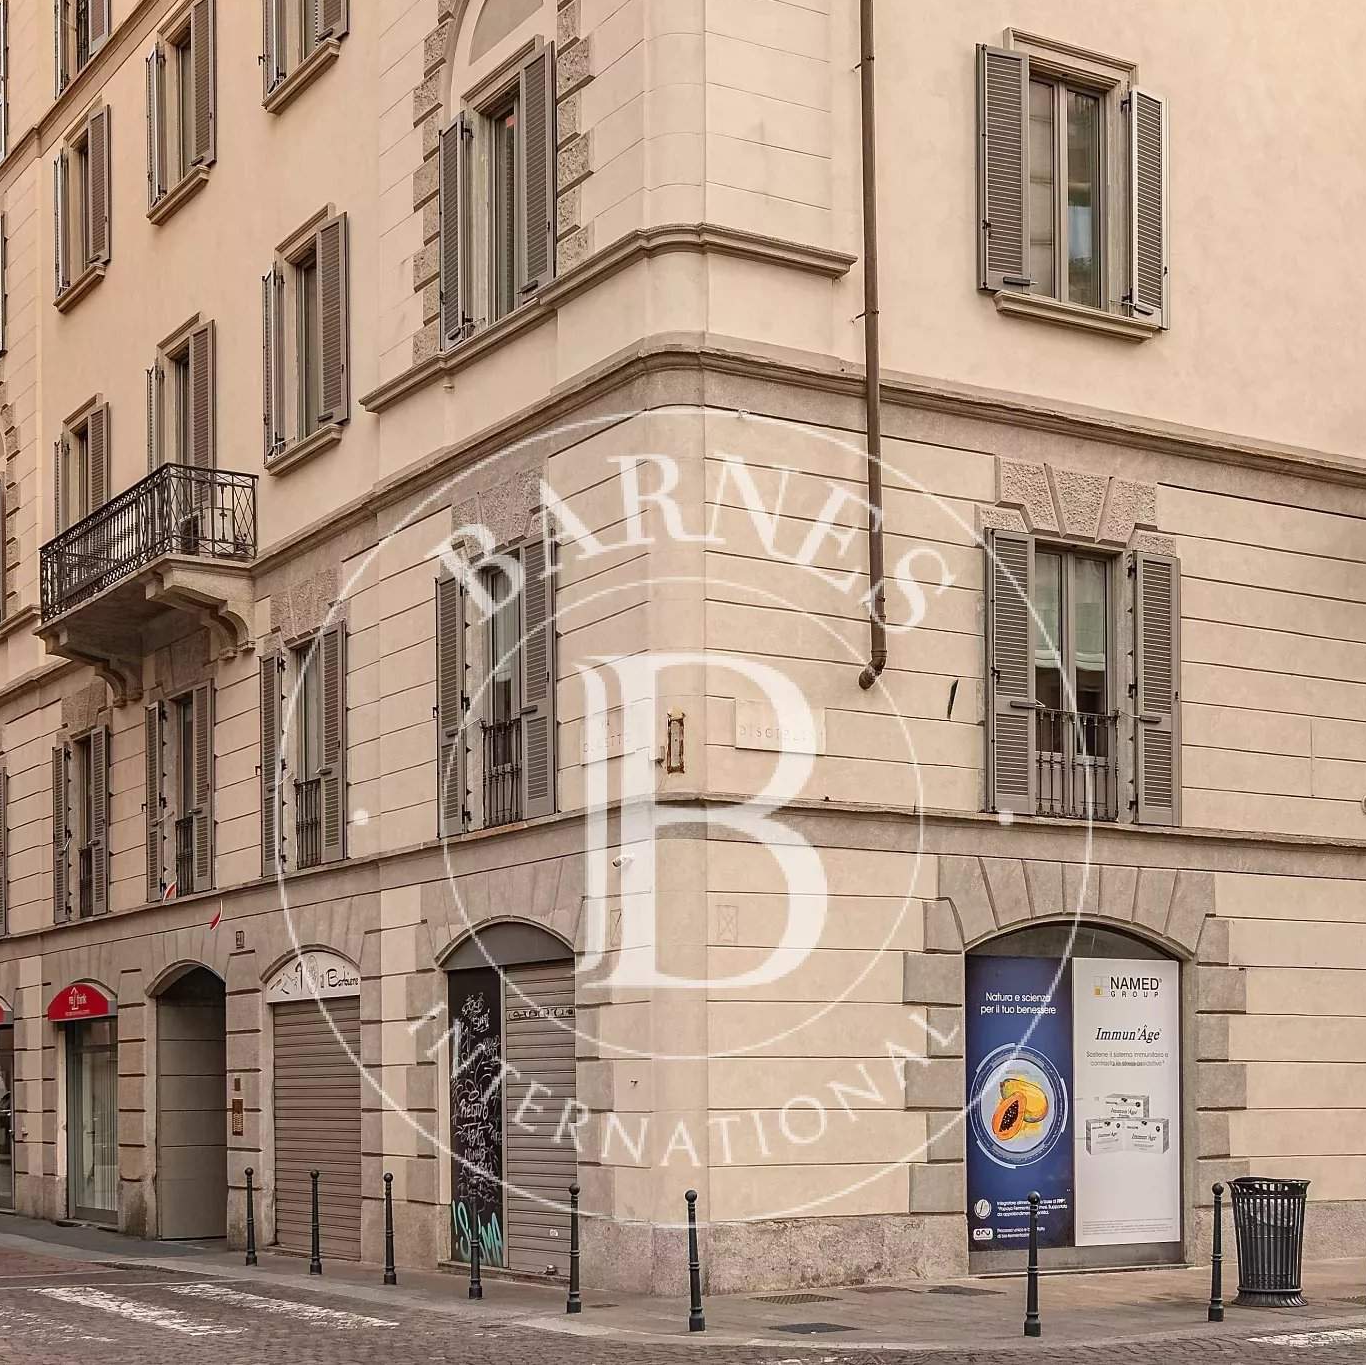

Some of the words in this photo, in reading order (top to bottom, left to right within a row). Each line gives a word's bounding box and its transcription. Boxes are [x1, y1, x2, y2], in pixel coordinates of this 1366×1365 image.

[985, 992, 1013, 1002] Natura
[1014, 994, 1021, 1002] e
[1110, 990, 1159, 998] GROUP
[980, 1005, 995, 1015] per
[996, 1004, 1001, 1013] il
[1002, 1004, 1015, 1013] tuo
[1016, 1004, 1057, 1014] benessere
